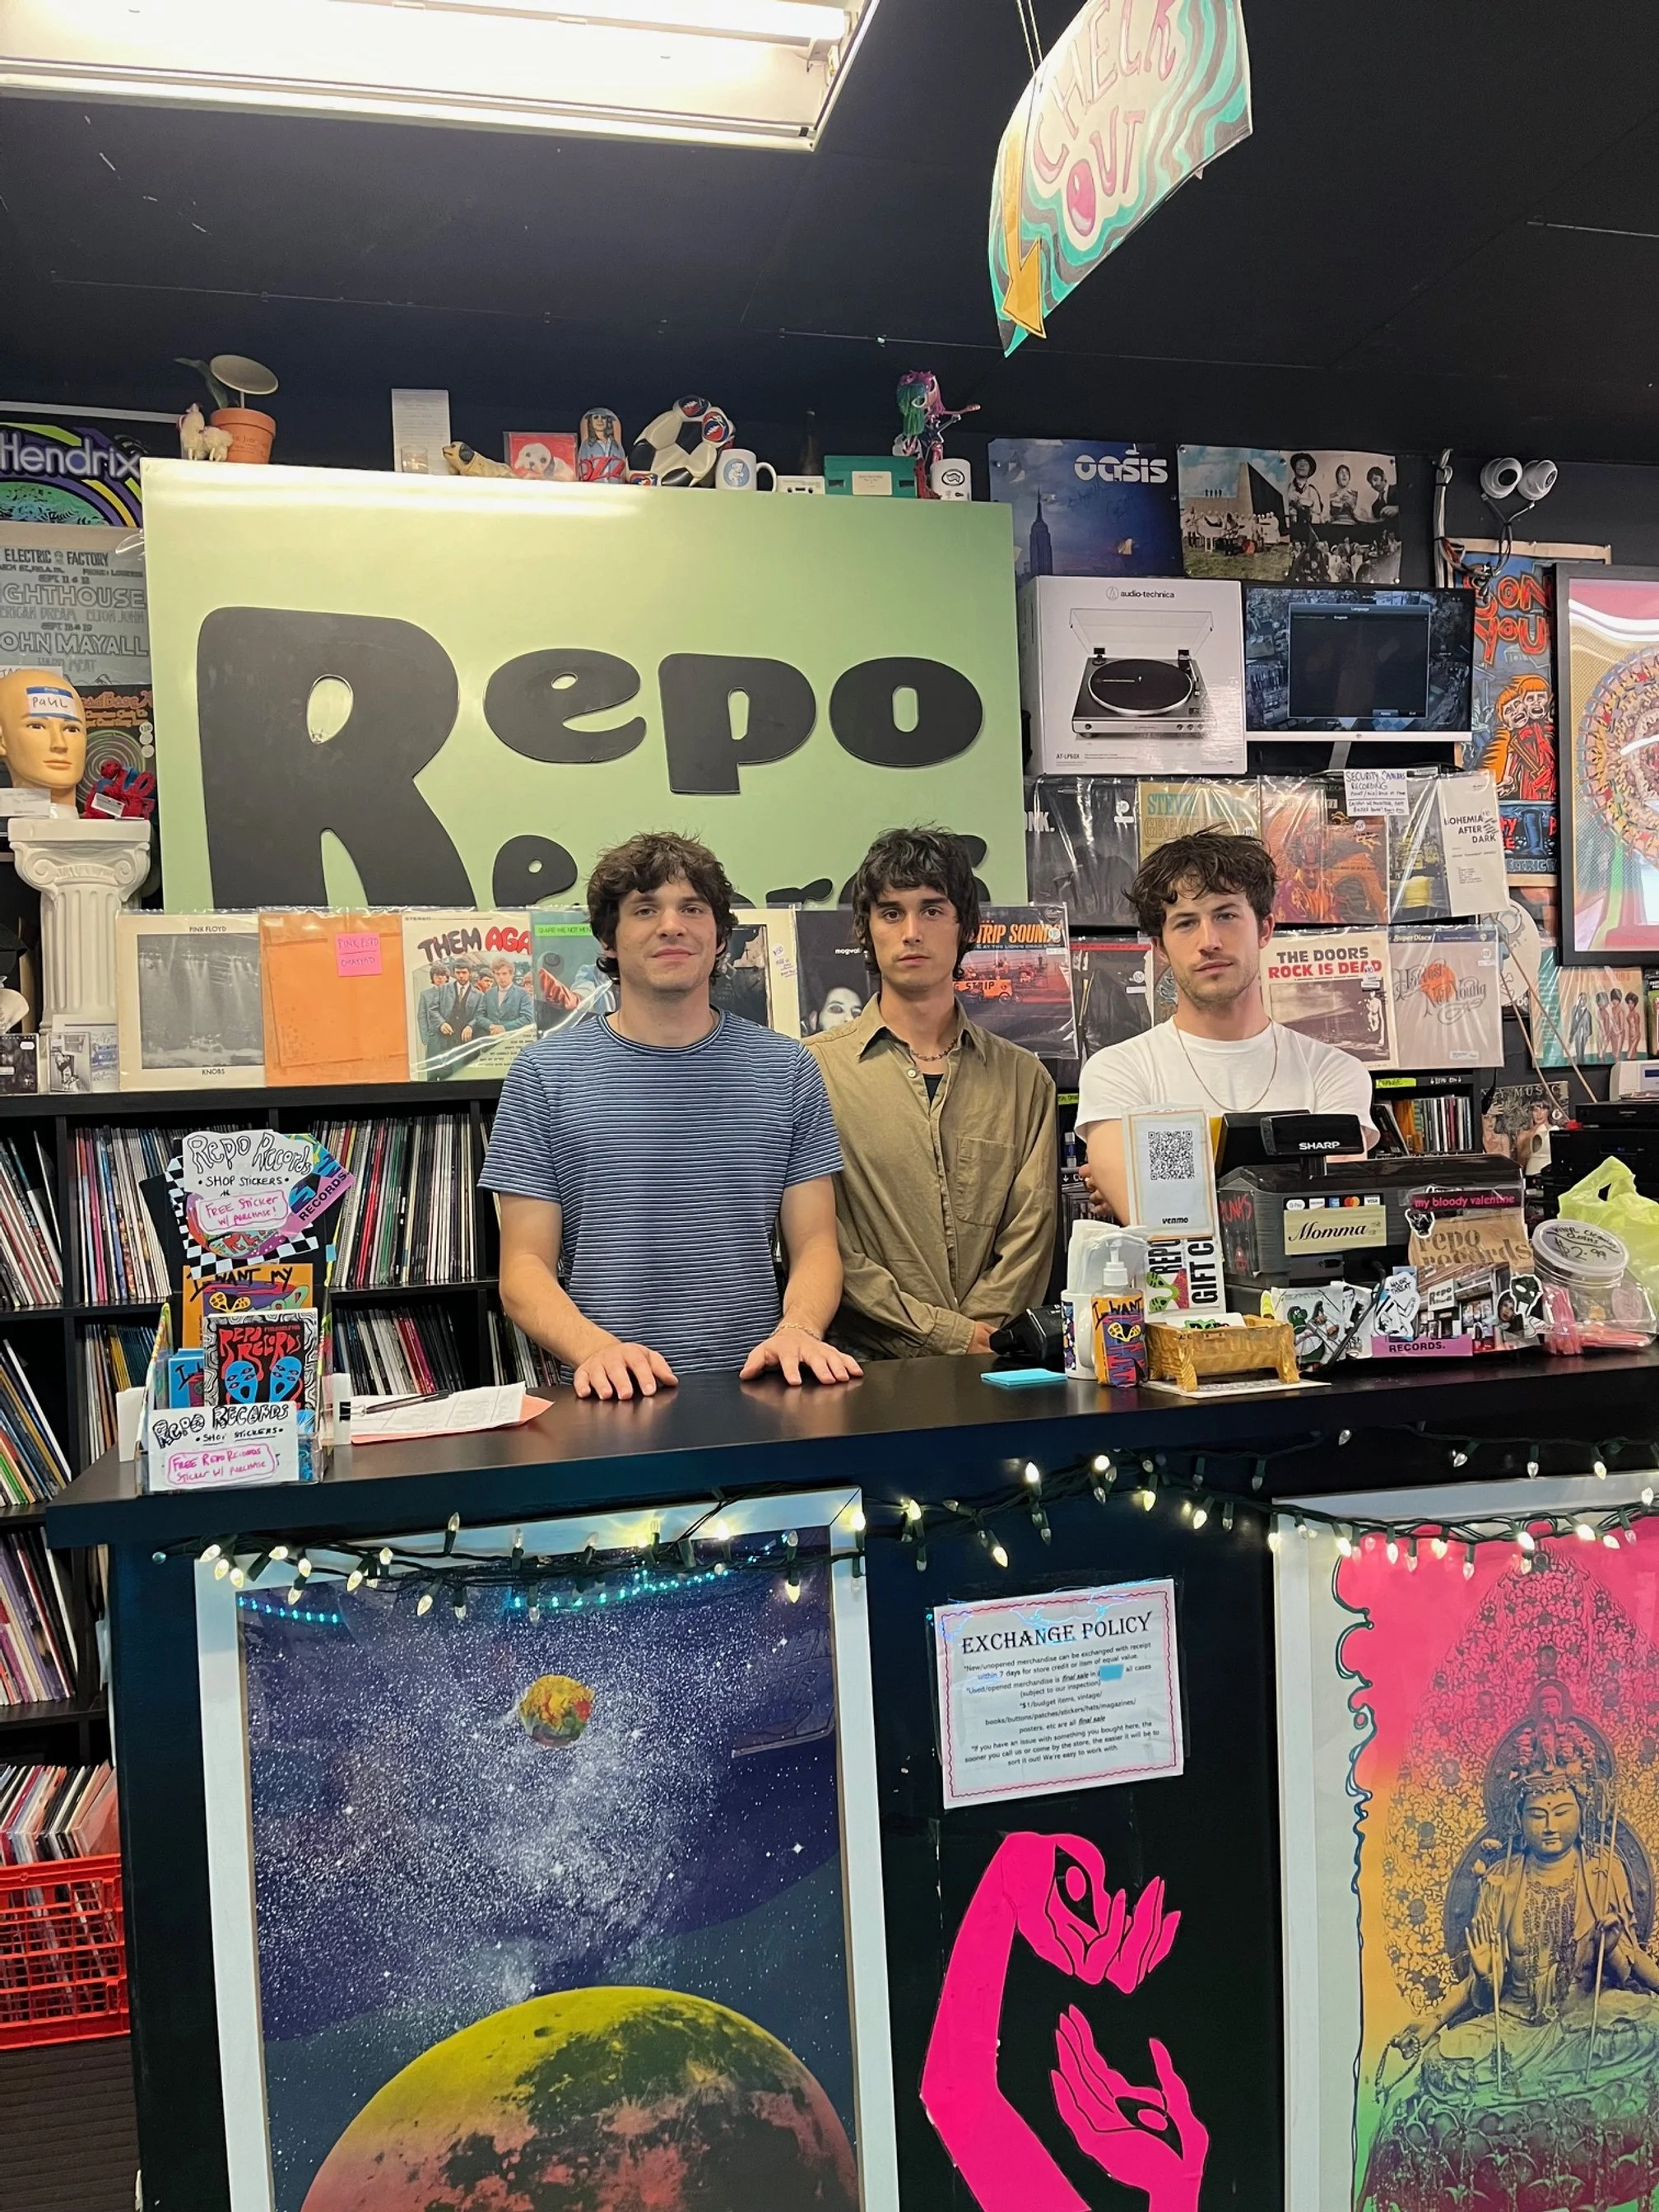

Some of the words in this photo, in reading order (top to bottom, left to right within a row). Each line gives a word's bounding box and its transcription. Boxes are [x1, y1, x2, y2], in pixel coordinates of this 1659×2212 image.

[1066, 105, 1146, 237] OUT
[0, 431, 141, 479] Hendrix
[5, 548, 53, 564] ELECTRIC
[67, 551, 109, 567] FACTORY
[1120, 590, 1175, 599] audio-technica
[56, 632, 150, 657] MAYALL
[198, 606, 983, 909] Repo
[1345, 771, 1379, 783] SECURITY
[1458, 825, 1482, 834] AFTER
[1472, 834, 1497, 843] DARK
[338, 938, 360, 949] PINK
[417, 927, 482, 963] THEM
[1276, 950, 1308, 964] THE
[1313, 946, 1369, 962] DOORS
[1268, 964, 1314, 979] ROCK
[1318, 963, 1334, 975] IS
[1299, 1141, 1341, 1150] SHARP
[206, 1175, 236, 1187] SHOP
[298, 1170, 351, 1222] RECORDS.
[1415, 1198, 1430, 1209] my
[1432, 1196, 1468, 1207] bloody
[1470, 1194, 1515, 1206] valentine
[205, 1202, 236, 1219] FREE
[1162, 1216, 1189, 1224] venmo
[1288, 1220, 1367, 1242] Momma
[1418, 1229, 1480, 1254] repo
[215, 1268, 261, 1286] WANT
[270, 1266, 293, 1292] MY
[1189, 1262, 1219, 1304] GIFT
[1109, 1297, 1142, 1315] WANT
[219, 1327, 262, 1368] REPO
[1388, 1341, 1446, 1353] RECORDS.
[172, 1457, 198, 1471] FREE
[962, 1624, 1076, 1654] EXCHANGE
[1082, 1610, 1153, 1639] POLICY
[1017, 1655, 1057, 1666] merchandise
[1081, 1647, 1113, 1657] exchanged
[1131, 1643, 1151, 1651] receipt
[1006, 1669, 1020, 1677] days
[1103, 1655, 1119, 1664] equal
[1013, 1677, 1053, 1688] merchandise
[1062, 1674, 1076, 1683] final
[1020, 1688, 1045, 1698] (subject
[1067, 1680, 1101, 1690] inspection)
[1077, 1691, 1102, 1701] vintage/
[1078, 1716, 1093, 1725] final
[1054, 1731, 1085, 1741] something
[1101, 1725, 1123, 1733] bought
